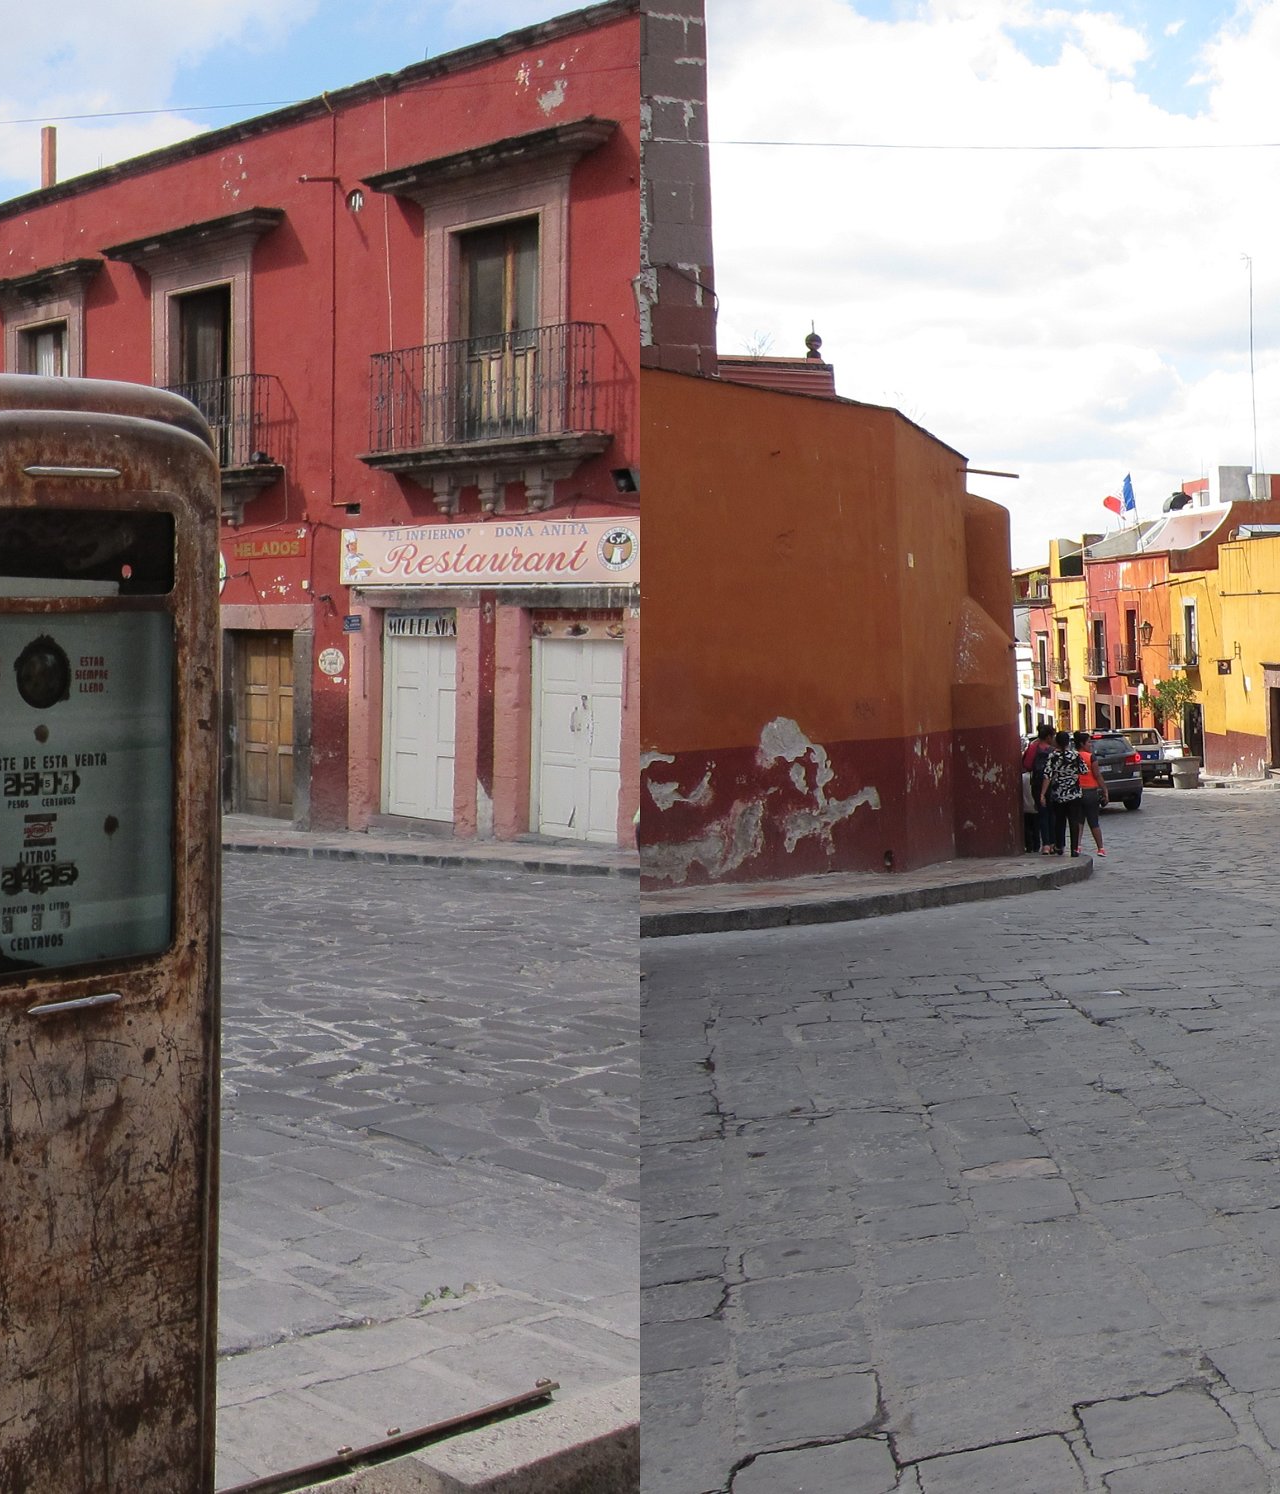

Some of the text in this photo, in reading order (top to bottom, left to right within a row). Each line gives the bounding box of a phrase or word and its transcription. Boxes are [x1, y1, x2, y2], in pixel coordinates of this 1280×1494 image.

[495, 523, 533, 537] DOÑA
[540, 523, 588, 536] ANITA
[234, 541, 300, 557] HELADOS
[379, 540, 589, 575] Restaurant
[80, 656, 105, 667] ESTAR
[75, 670, 108, 681] SIEMPRE
[23, 756, 37, 770] DE
[43, 755, 68, 769] ESTA
[75, 753, 108, 768] VENTA
[8, 796, 76, 809] PESOS CENTAVOS
[20, 849, 57, 863] LITROS
[3, 901, 70, 915] PRECIO POR LITRO
[10, 934, 64, 952] CENTAVOS
